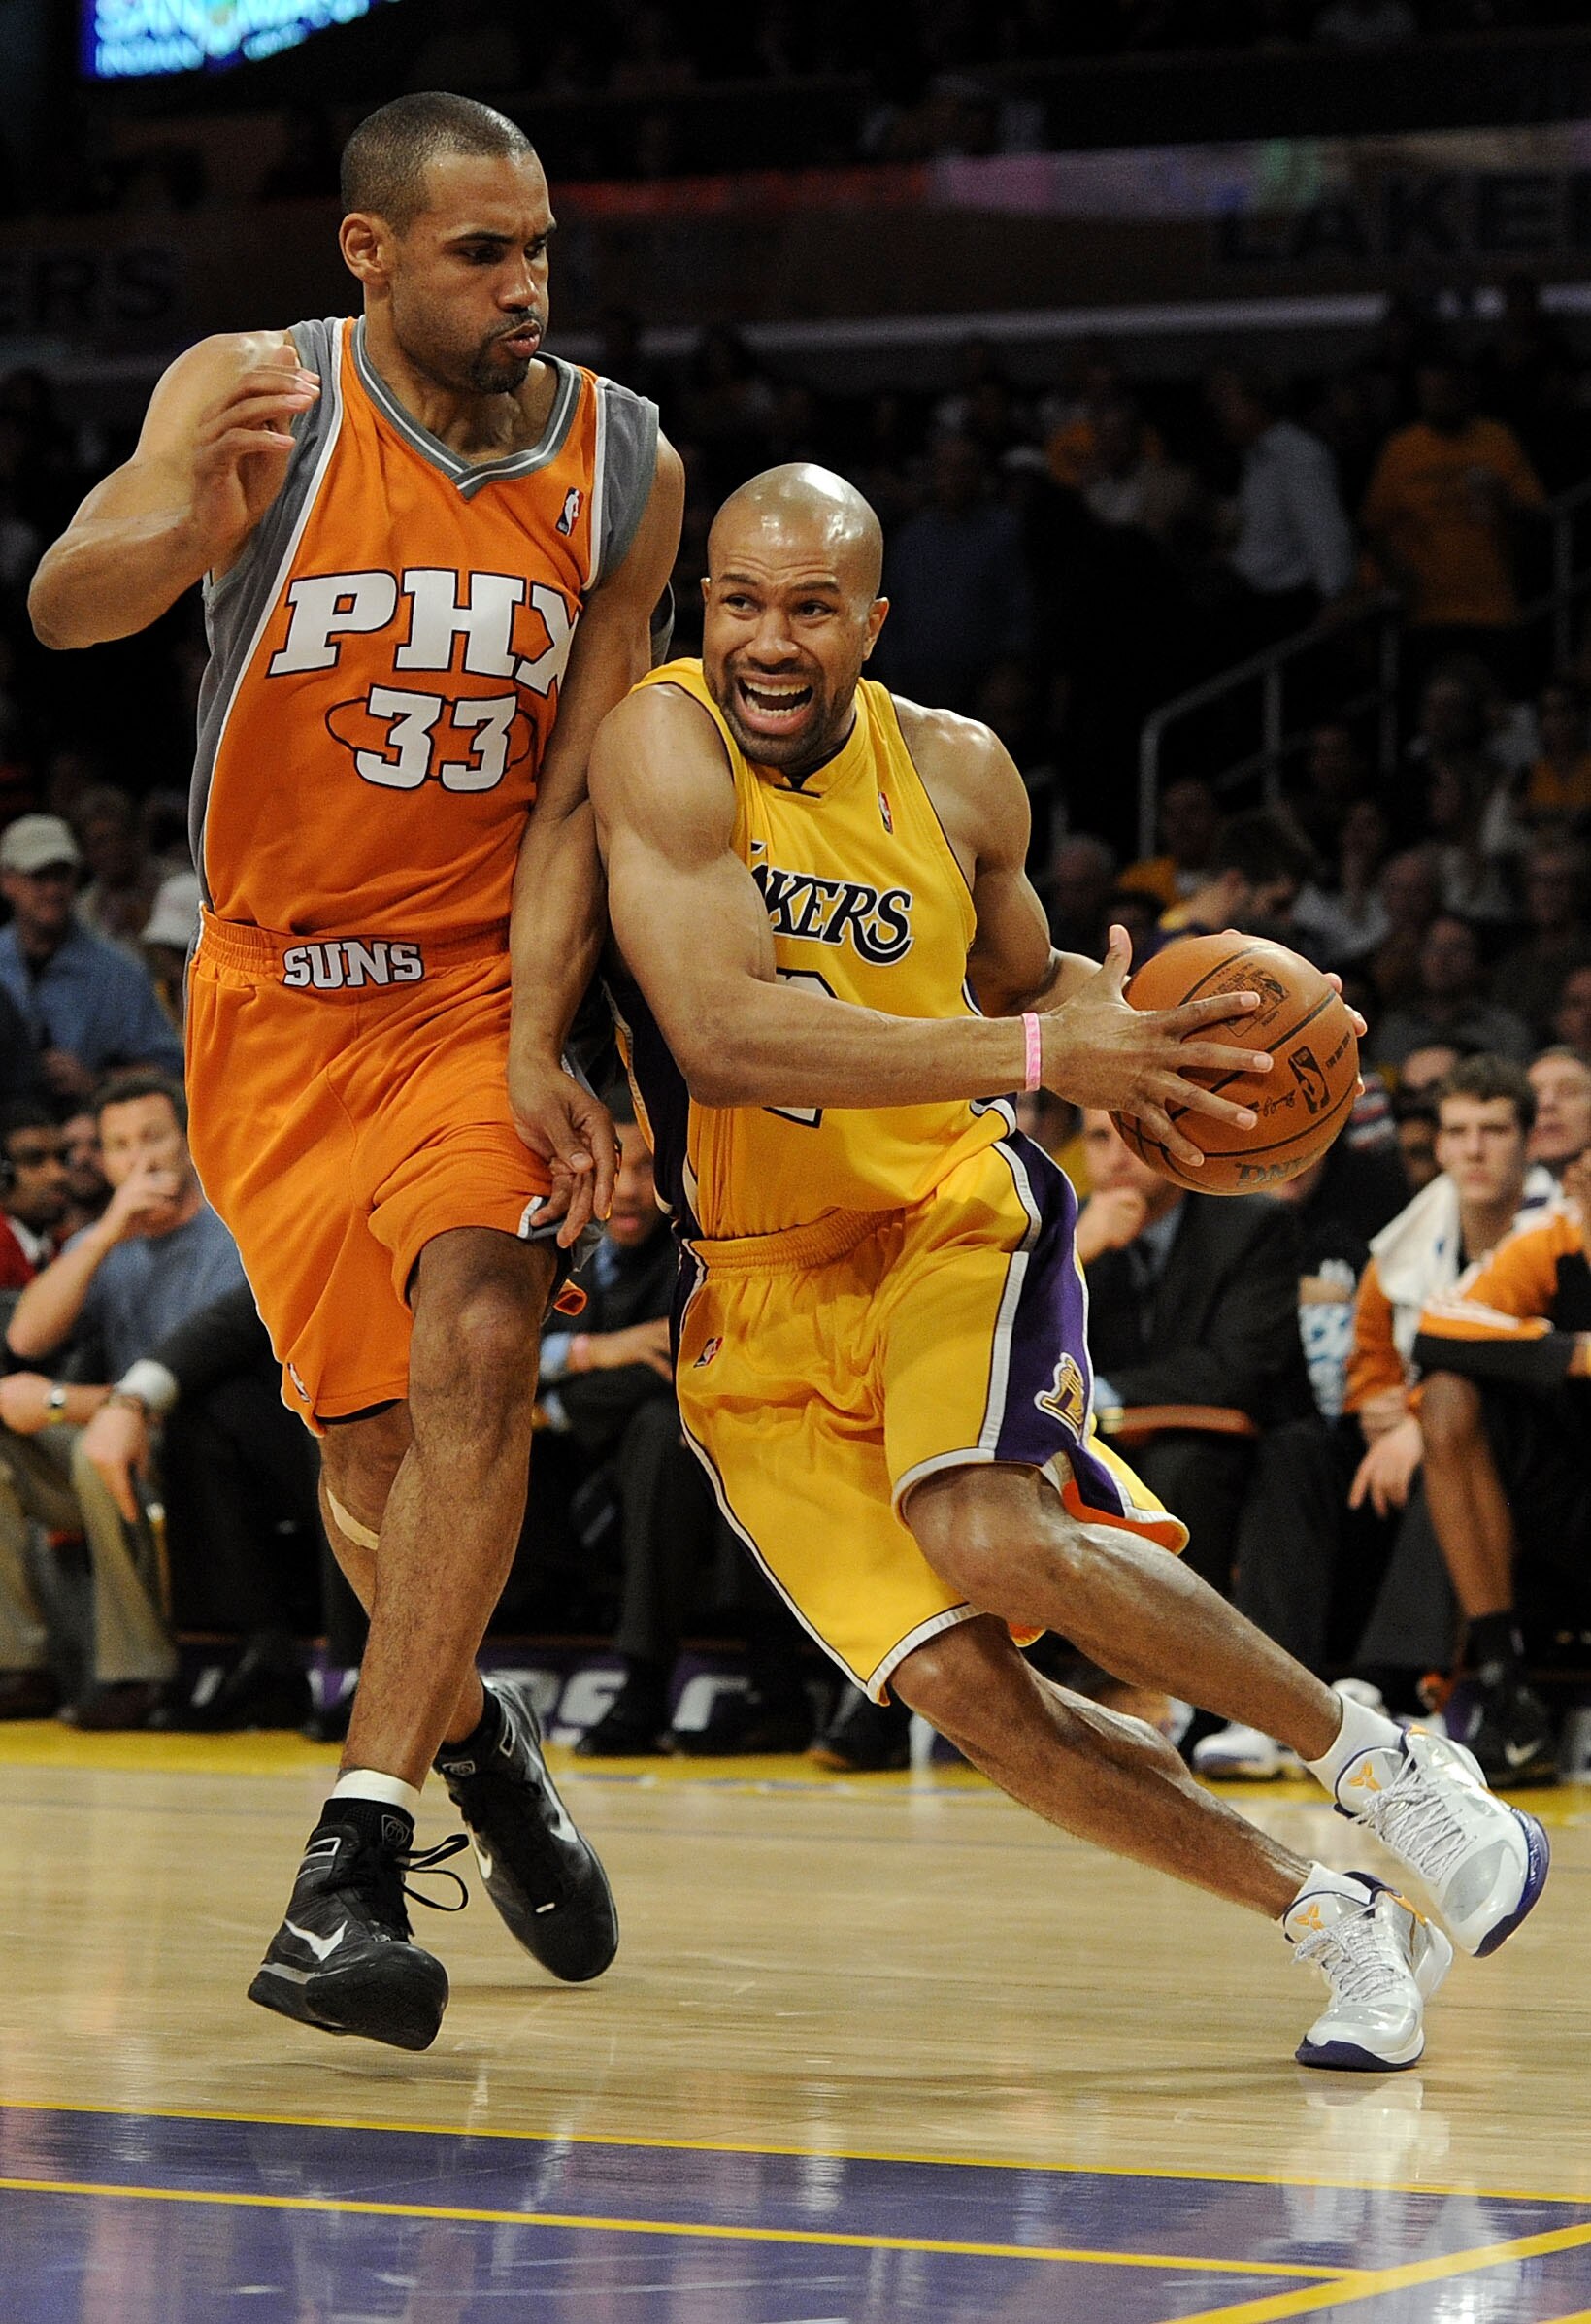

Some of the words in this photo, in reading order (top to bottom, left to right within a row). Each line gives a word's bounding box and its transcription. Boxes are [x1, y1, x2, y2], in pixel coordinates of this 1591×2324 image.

[265, 567, 582, 697] PHX
[353, 683, 518, 792] 33
[282, 940, 424, 990] SUNS
